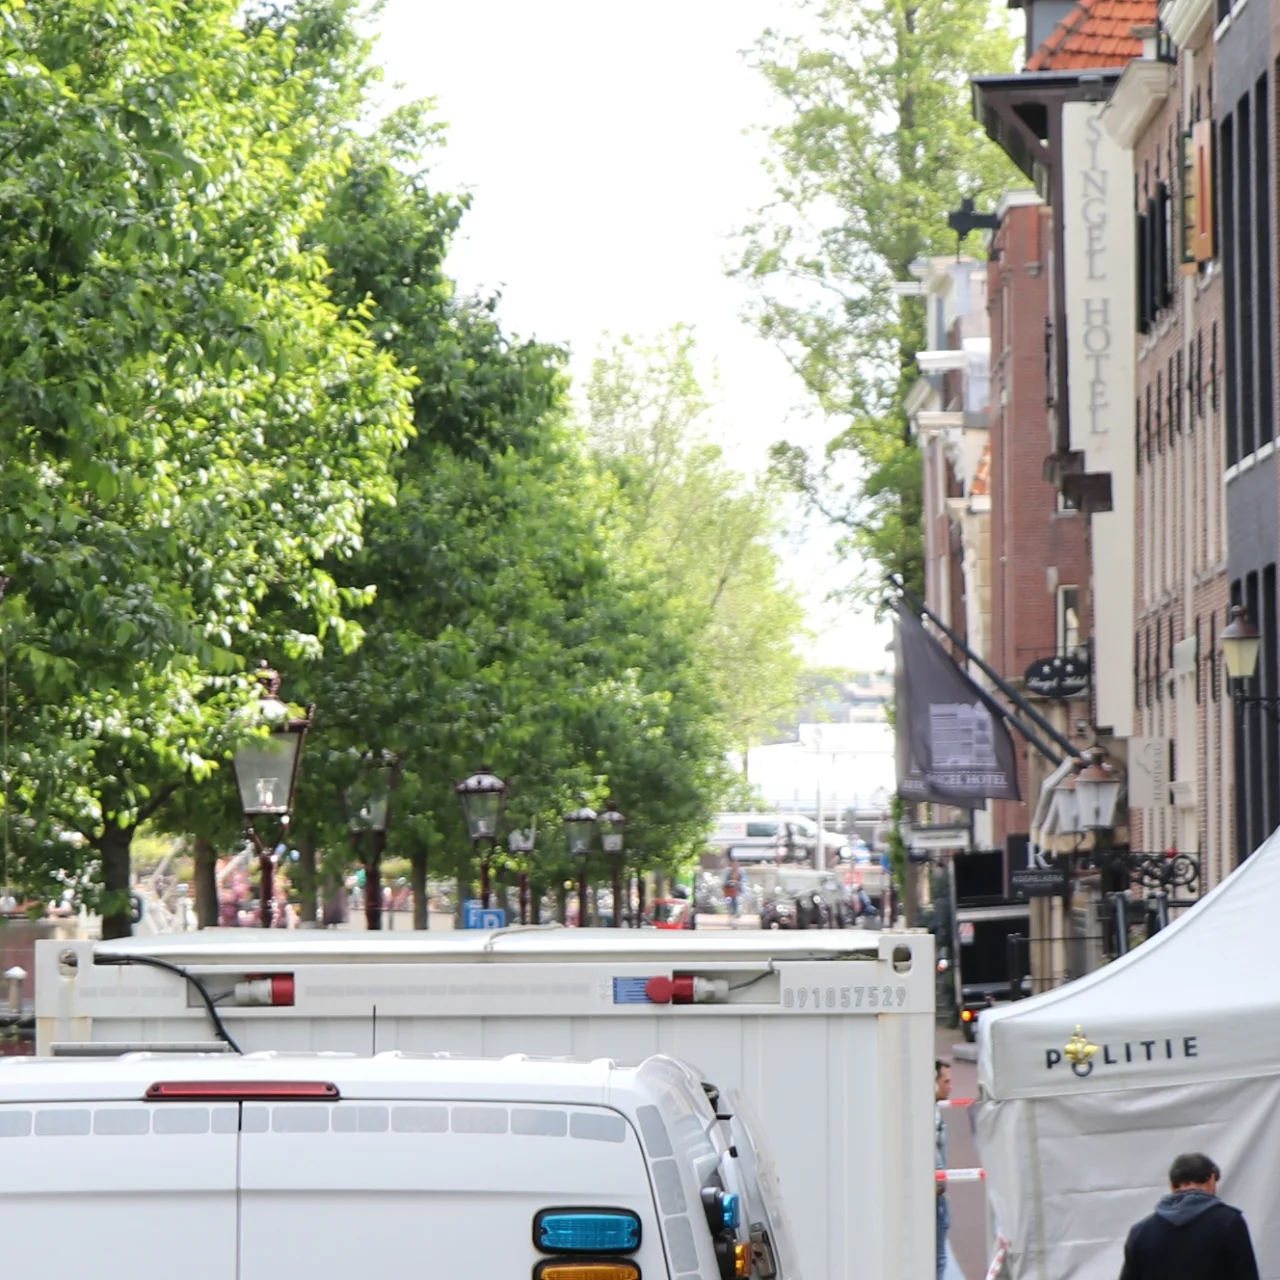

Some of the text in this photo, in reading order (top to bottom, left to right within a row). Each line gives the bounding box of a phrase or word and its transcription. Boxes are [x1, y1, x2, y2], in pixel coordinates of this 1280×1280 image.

[1081, 114, 1111, 435] SINGEL HOTEL
[783, 986, 907, 1008] 091857529
